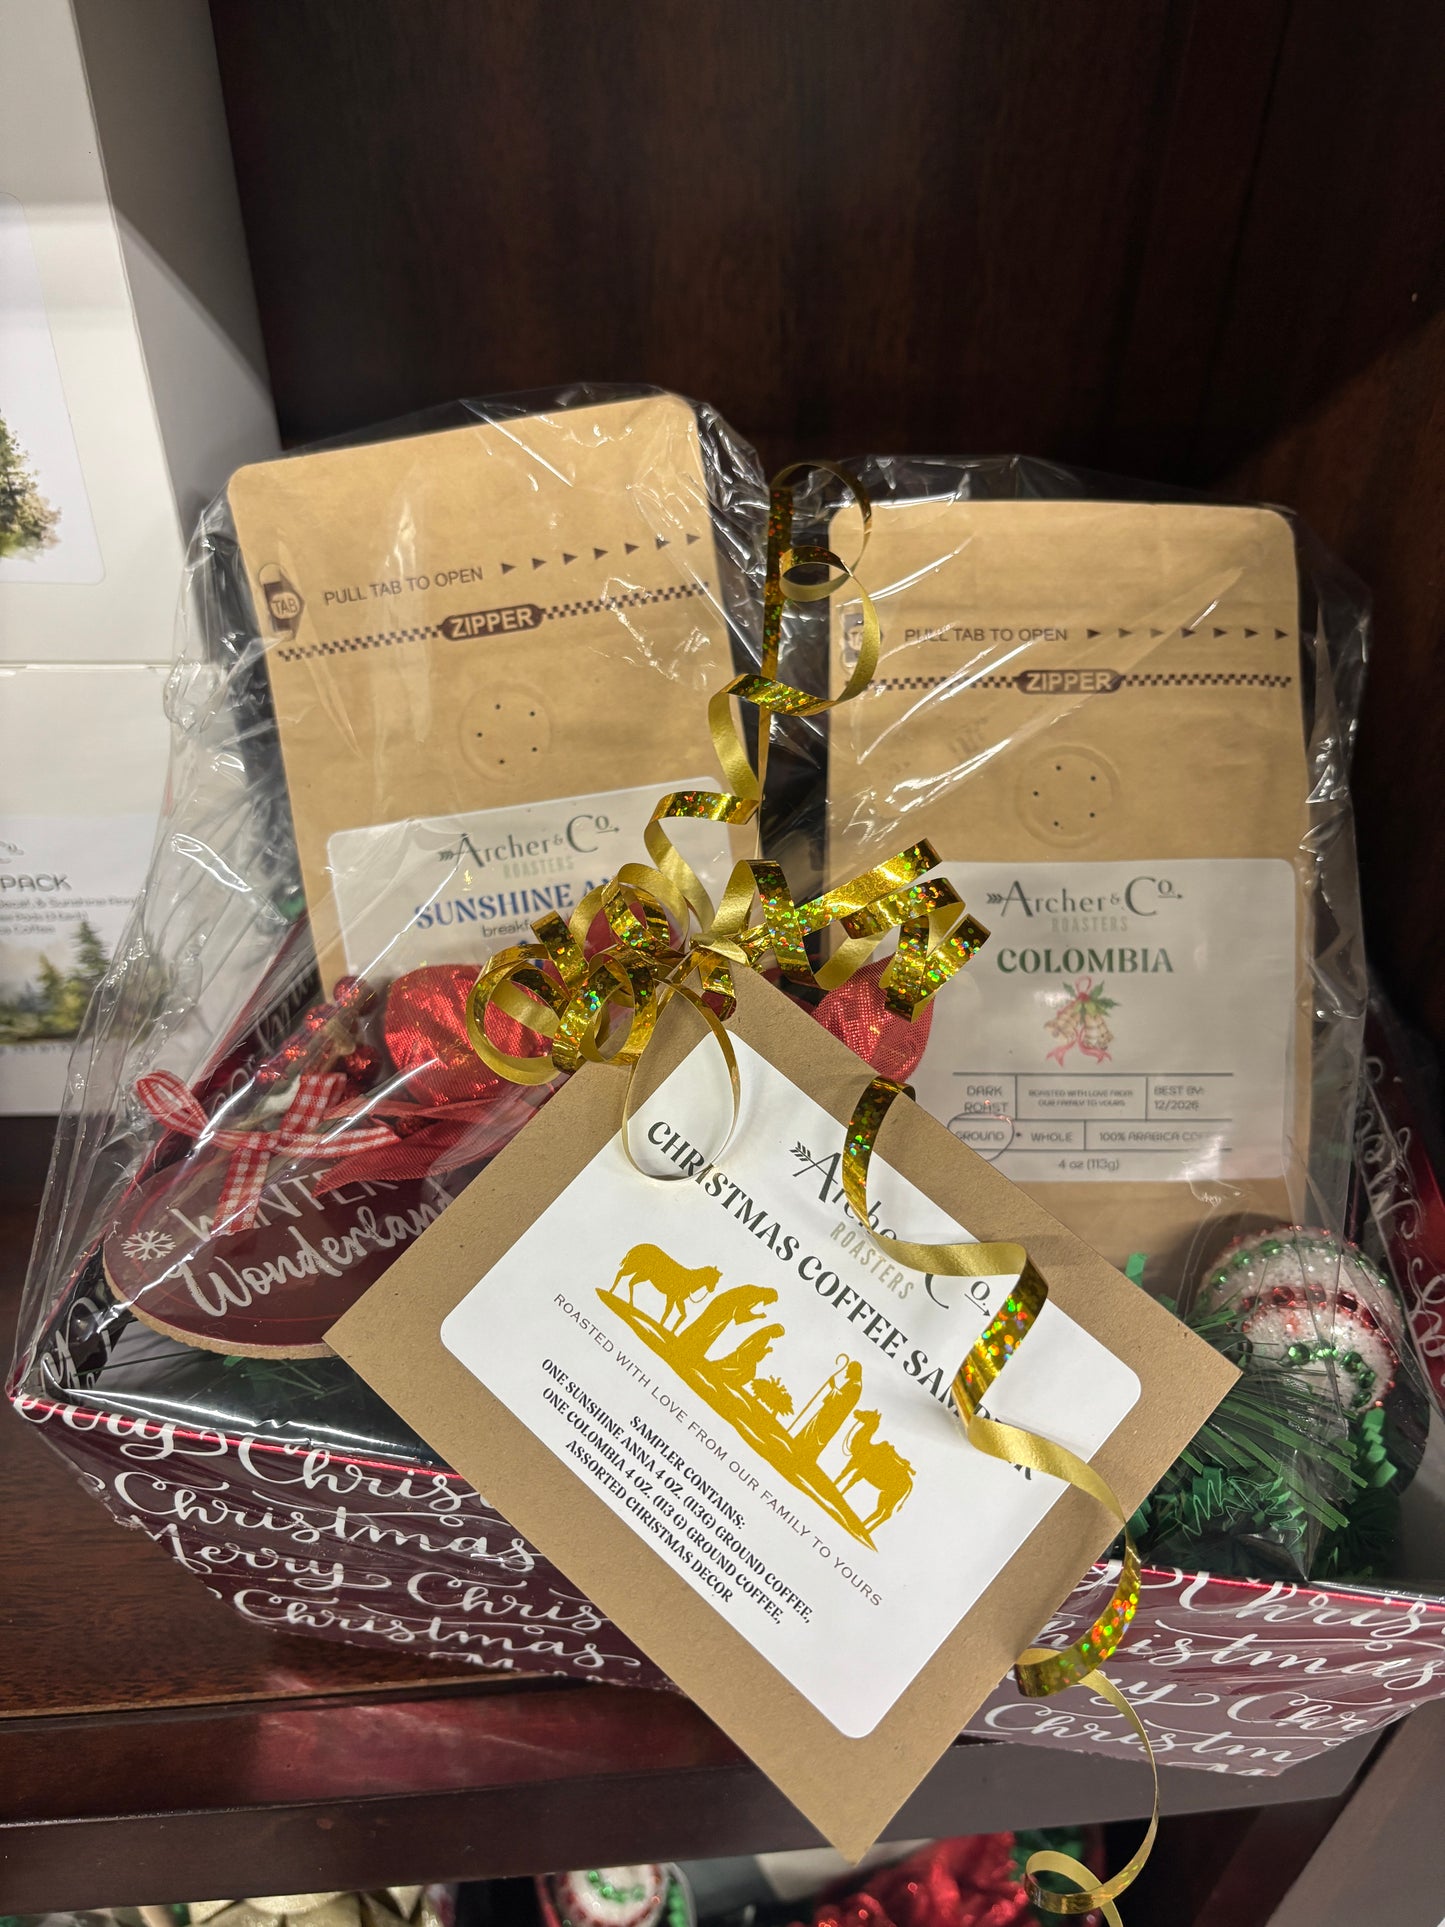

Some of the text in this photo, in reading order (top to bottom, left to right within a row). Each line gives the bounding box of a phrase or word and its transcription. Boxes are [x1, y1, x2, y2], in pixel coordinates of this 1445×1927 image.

[324, 568, 484, 606] PULL TAB TO OPEN
[273, 598, 298, 613] TAB
[448, 608, 535, 639] ZIPPER
[905, 629, 1068, 641] PULL TAB TO OPEN
[1026, 672, 1113, 690] ZIPPER
[454, 833, 549, 868] Archer
[0, 873, 72, 893] PACK
[502, 856, 575, 879] ROASTERS
[414, 883, 574, 930] SUNSHINE
[999, 880, 1104, 918] Archer
[482, 919, 531, 938] breakf
[1051, 915, 1128, 933] ROASTERS
[996, 947, 1174, 974] COLOMBIA
[966, 1085, 1002, 1097] DARK
[1154, 1085, 1184, 1096] BEST
[964, 1102, 1009, 1115] ROAST
[1031, 1131, 1073, 1142] WHOLE
[1099, 1131, 1126, 1142] 100%
[1128, 1131, 1180, 1142] ARABICA
[1058, 1160, 1066, 1169] 4
[648, 1120, 800, 1261] CHRISTMAS
[798, 1256, 909, 1359] COFFEE
[830, 1222, 914, 1300] ROASTERS
[553, 1294, 883, 1607] ROASTED WITH LOVE FROM OUR FAMILY TO YOURS
[630, 1415, 746, 1530] SAMPLER CONTAINS:
[542, 1359, 569, 1385] ONE
[566, 1381, 624, 1440] SUNSHINE
[621, 1436, 656, 1472] ANNA
[656, 1469, 666, 1480] 4
[664, 1477, 684, 1499] OZ.
[715, 1526, 766, 1575] GROUND
[764, 1573, 813, 1623] COFFEE,
[542, 1388, 570, 1414] ONE
[567, 1411, 626, 1471] COLOMBIA
[625, 1468, 636, 1479] 4
[633, 1476, 653, 1498] OZ.
[673, 1513, 688, 1530] G)
[686, 1527, 737, 1576] GROUND
[735, 1573, 784, 1624] COFFEE,
[114, 1471, 545, 1572] Christmas
[566, 1440, 733, 1603] ASSORTED CHRISTMAS DECOR
[407, 1571, 602, 1631] Chris
[234, 1588, 641, 1668] Christmas
